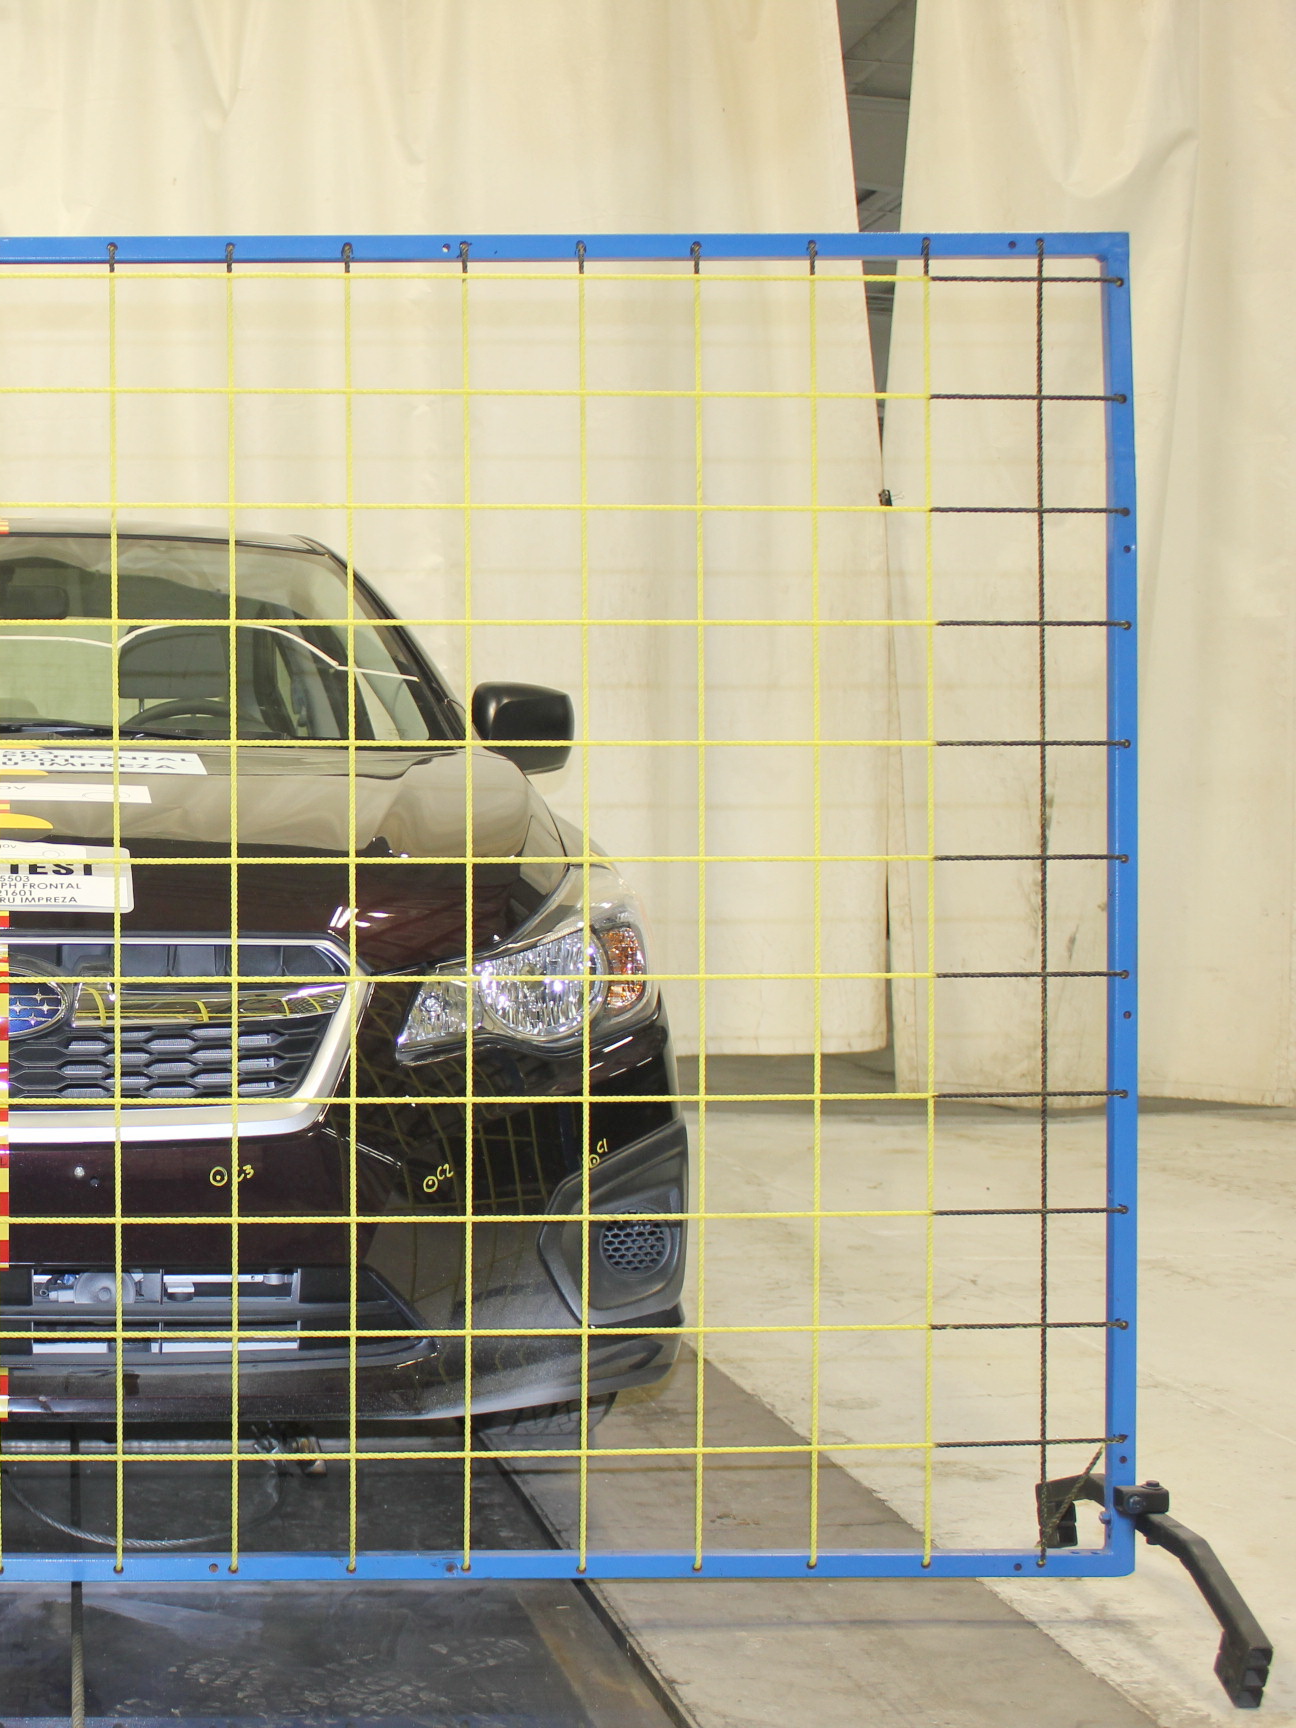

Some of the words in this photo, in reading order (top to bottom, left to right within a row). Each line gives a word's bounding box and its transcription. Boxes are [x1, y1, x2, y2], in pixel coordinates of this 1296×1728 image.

[53, 754, 194, 763] FRONTAL
[39, 762, 177, 770] IMPREZA
[22, 882, 82, 890] FRONTAL
[20, 896, 78, 904] IMPREZA
[436, 1163, 454, 1180] C2
